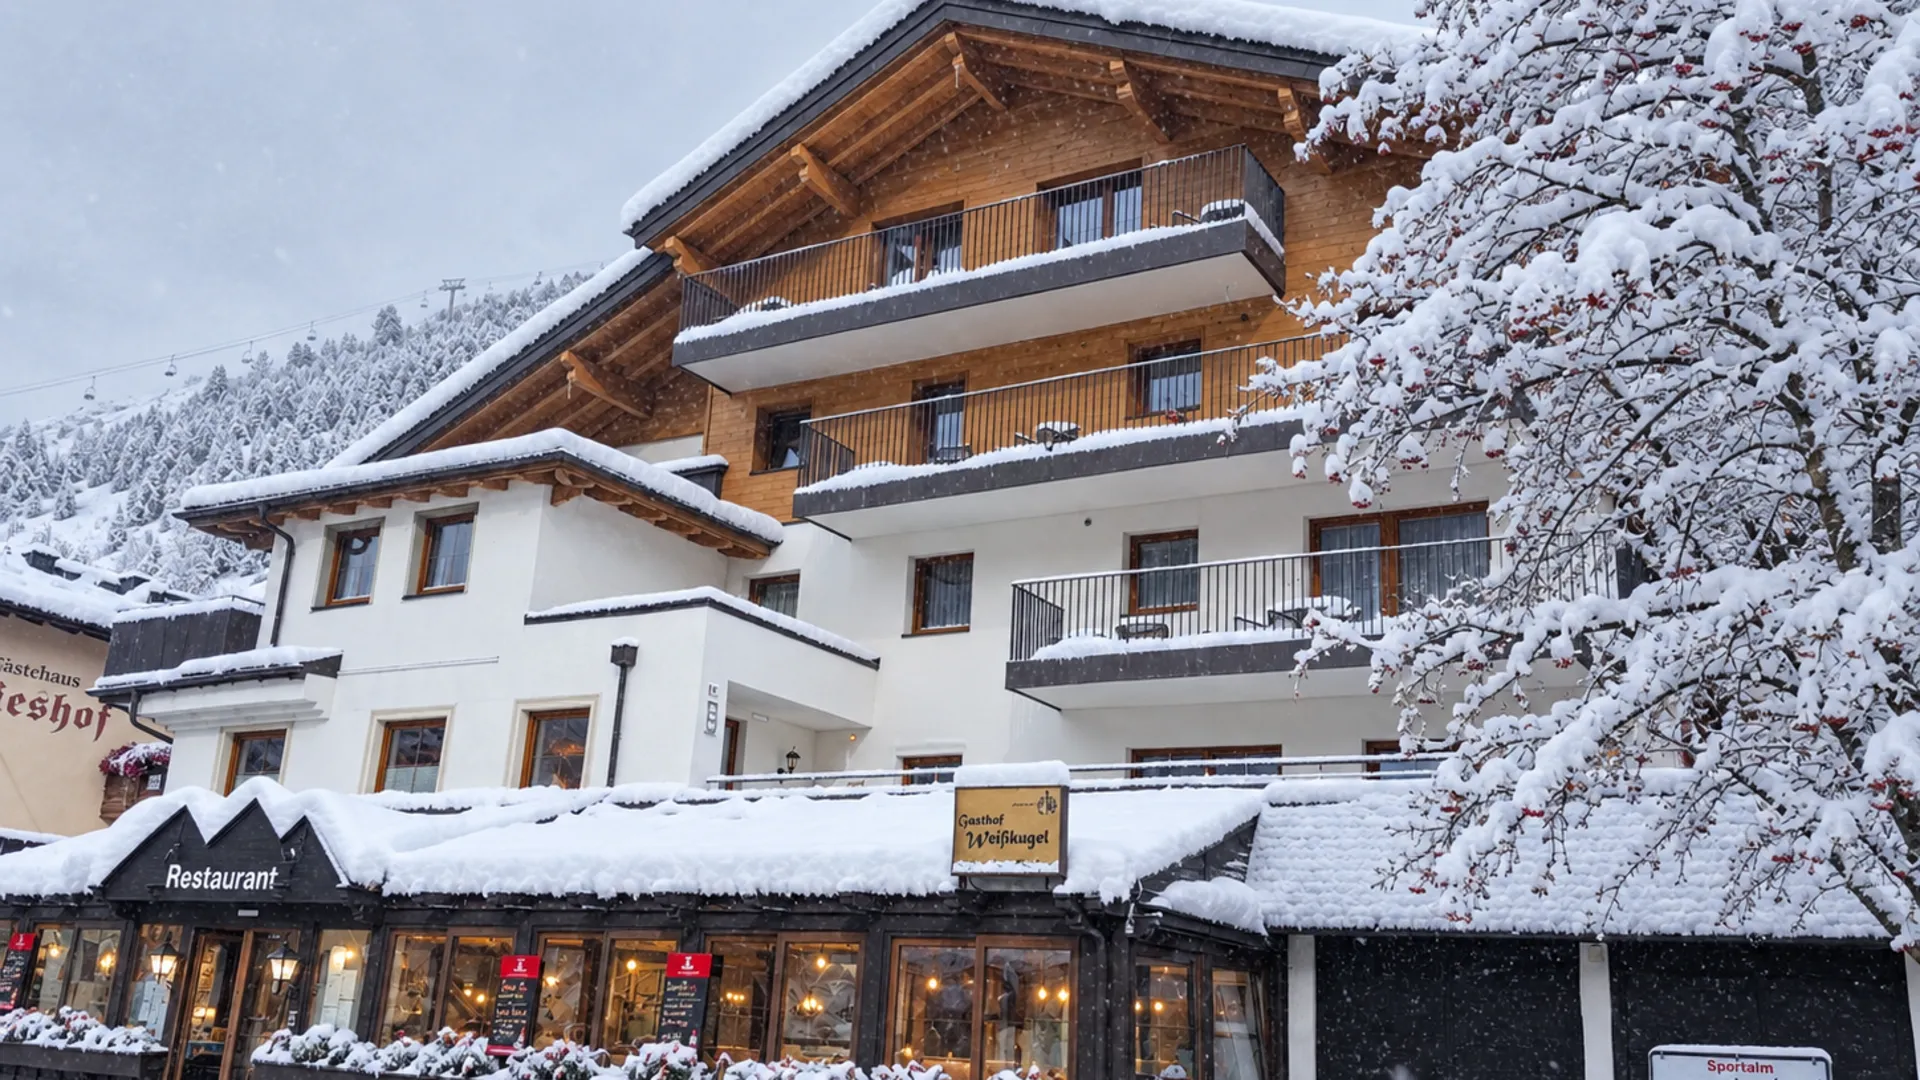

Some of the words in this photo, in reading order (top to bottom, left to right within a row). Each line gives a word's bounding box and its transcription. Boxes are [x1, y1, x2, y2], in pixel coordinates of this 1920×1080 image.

[958, 813, 1005, 829] Gasthof
[966, 829, 1049, 850] Weißkugel
[165, 863, 279, 890] Restaurant
[1707, 1059, 1774, 1074] Sportalm
